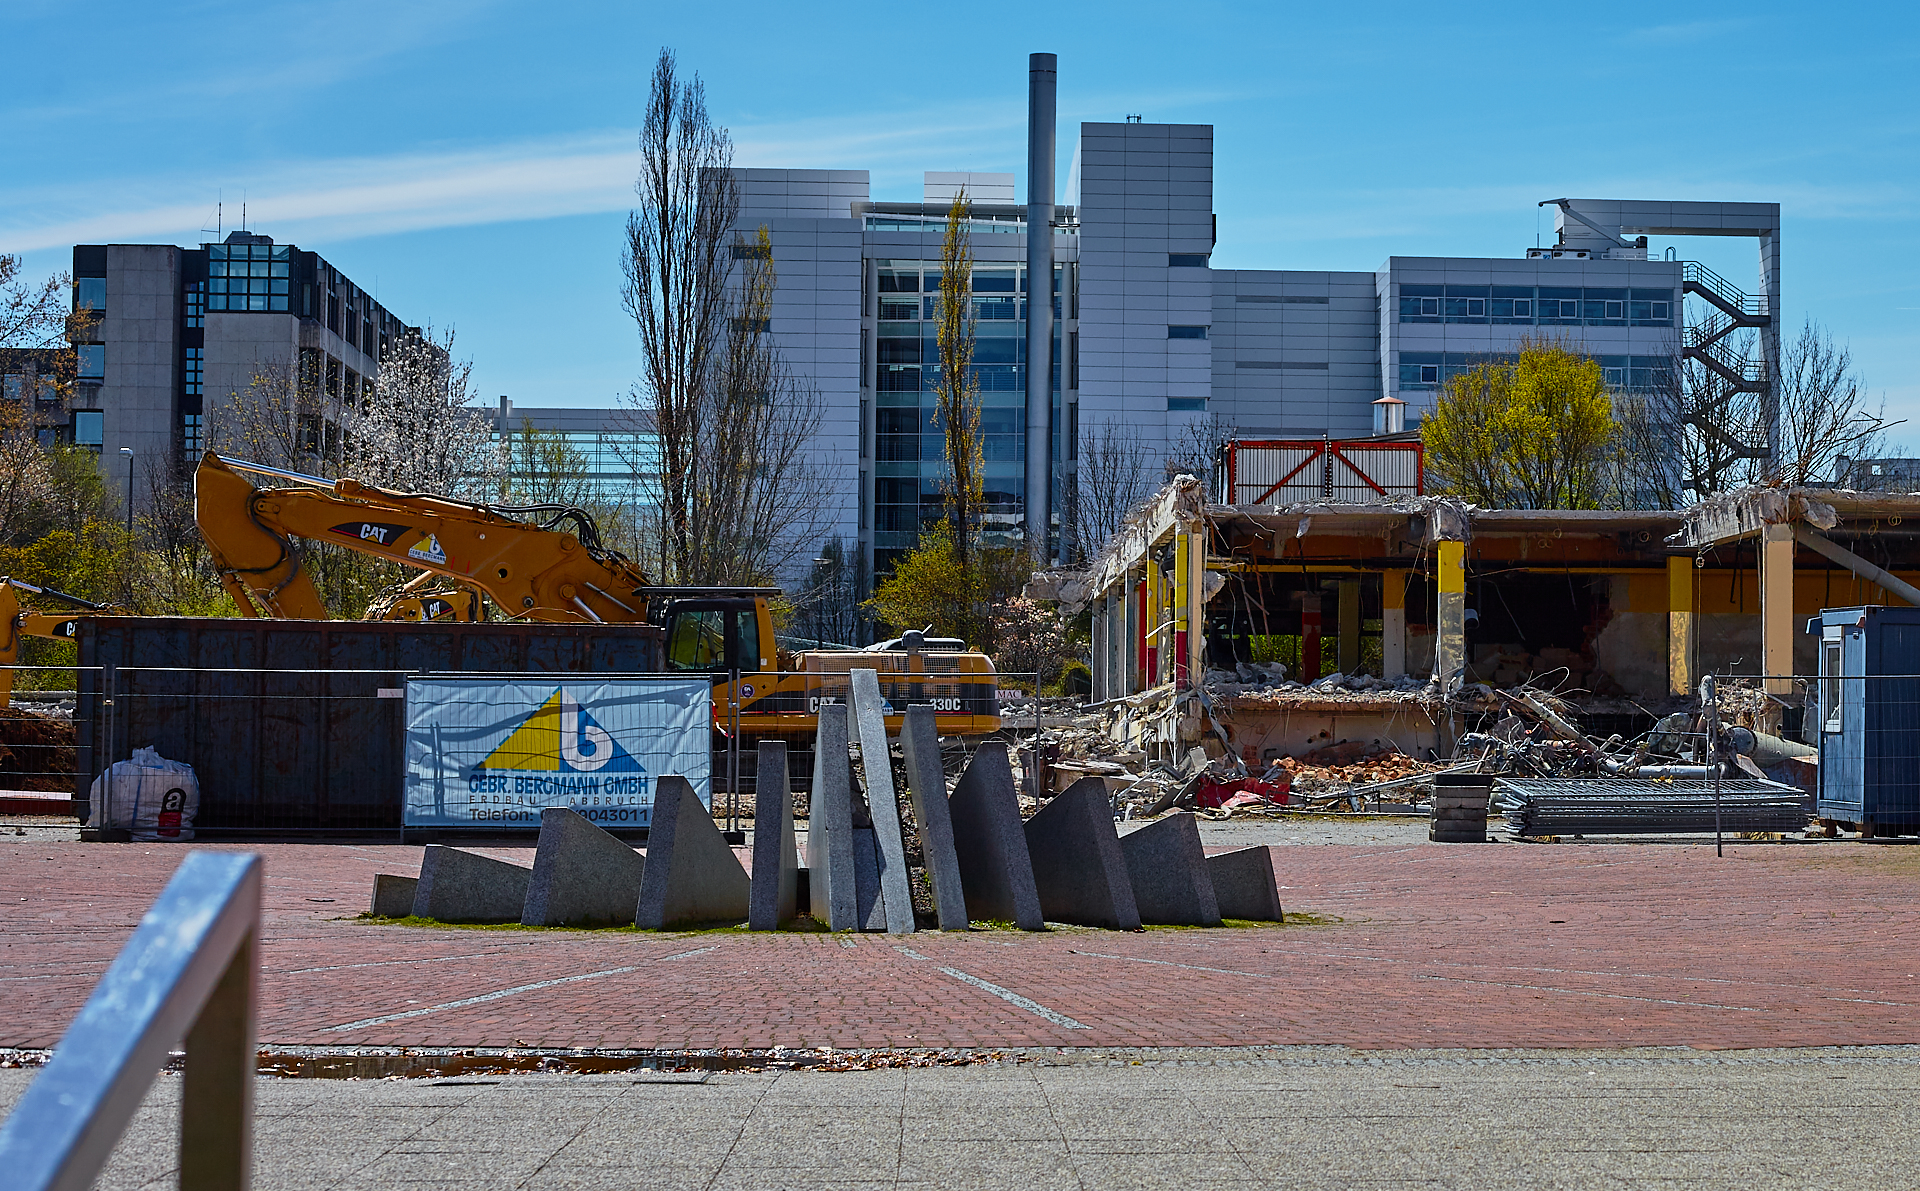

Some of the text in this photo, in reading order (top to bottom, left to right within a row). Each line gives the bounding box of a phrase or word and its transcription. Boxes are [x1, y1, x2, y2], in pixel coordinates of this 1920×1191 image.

[360, 523, 387, 544] CAT
[429, 601, 440, 618] CAT
[997, 690, 1020, 699] MAC
[469, 774, 648, 795] GEBR. BERGMANN GMBH
[469, 795, 648, 805] ERDBAU ABBRUCH
[469, 808, 534, 822] Telefon:
